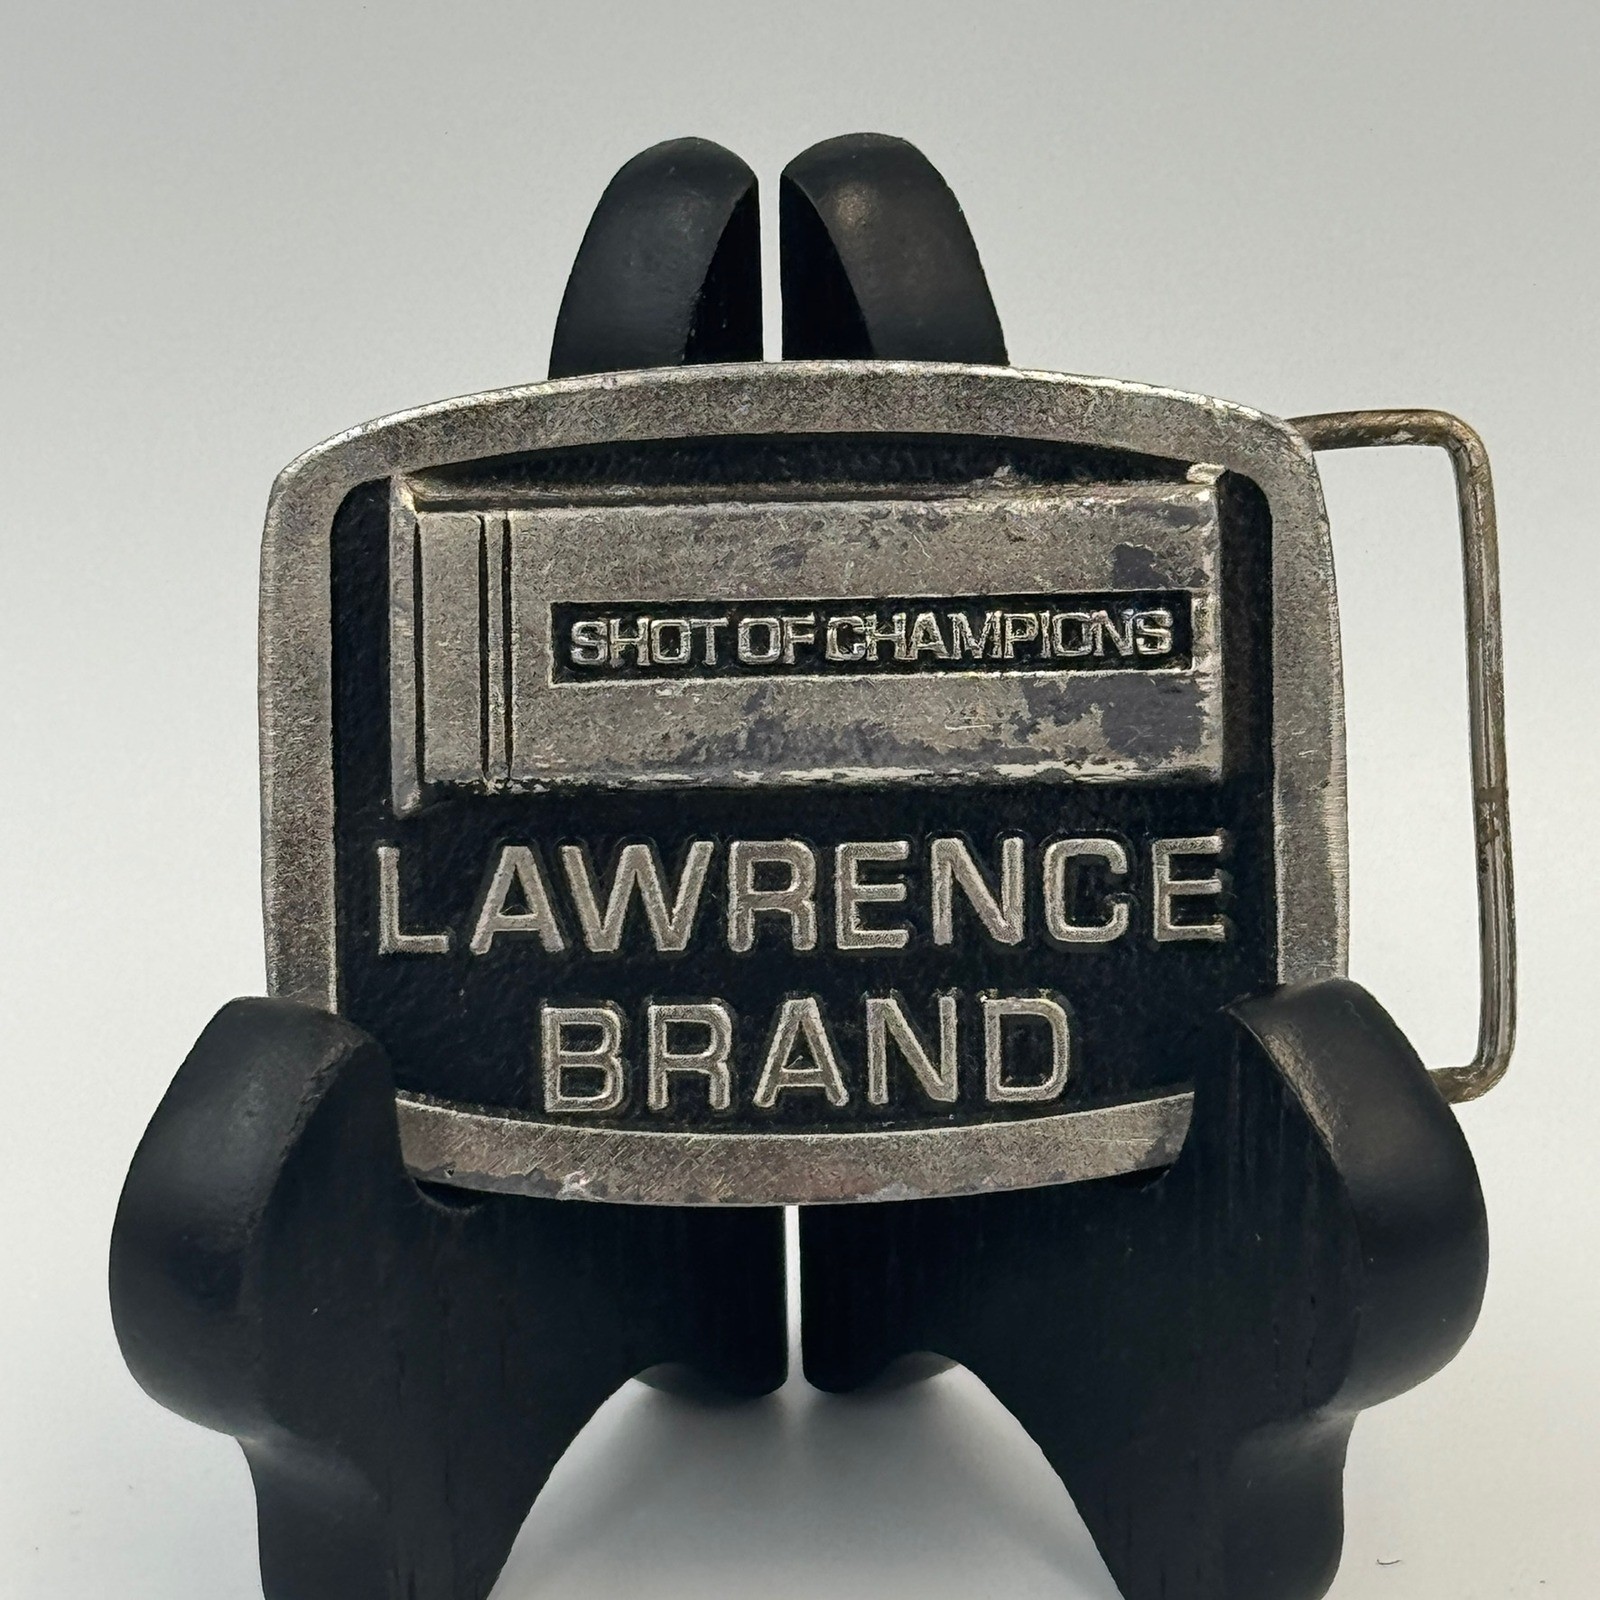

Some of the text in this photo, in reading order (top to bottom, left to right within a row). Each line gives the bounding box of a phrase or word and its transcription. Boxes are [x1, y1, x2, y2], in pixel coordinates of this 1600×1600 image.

[570, 608, 1173, 667] SHOT OF CHAMPIONS
[376, 834, 1227, 956] LAWRENCE
[541, 995, 1072, 1113] BRAND
